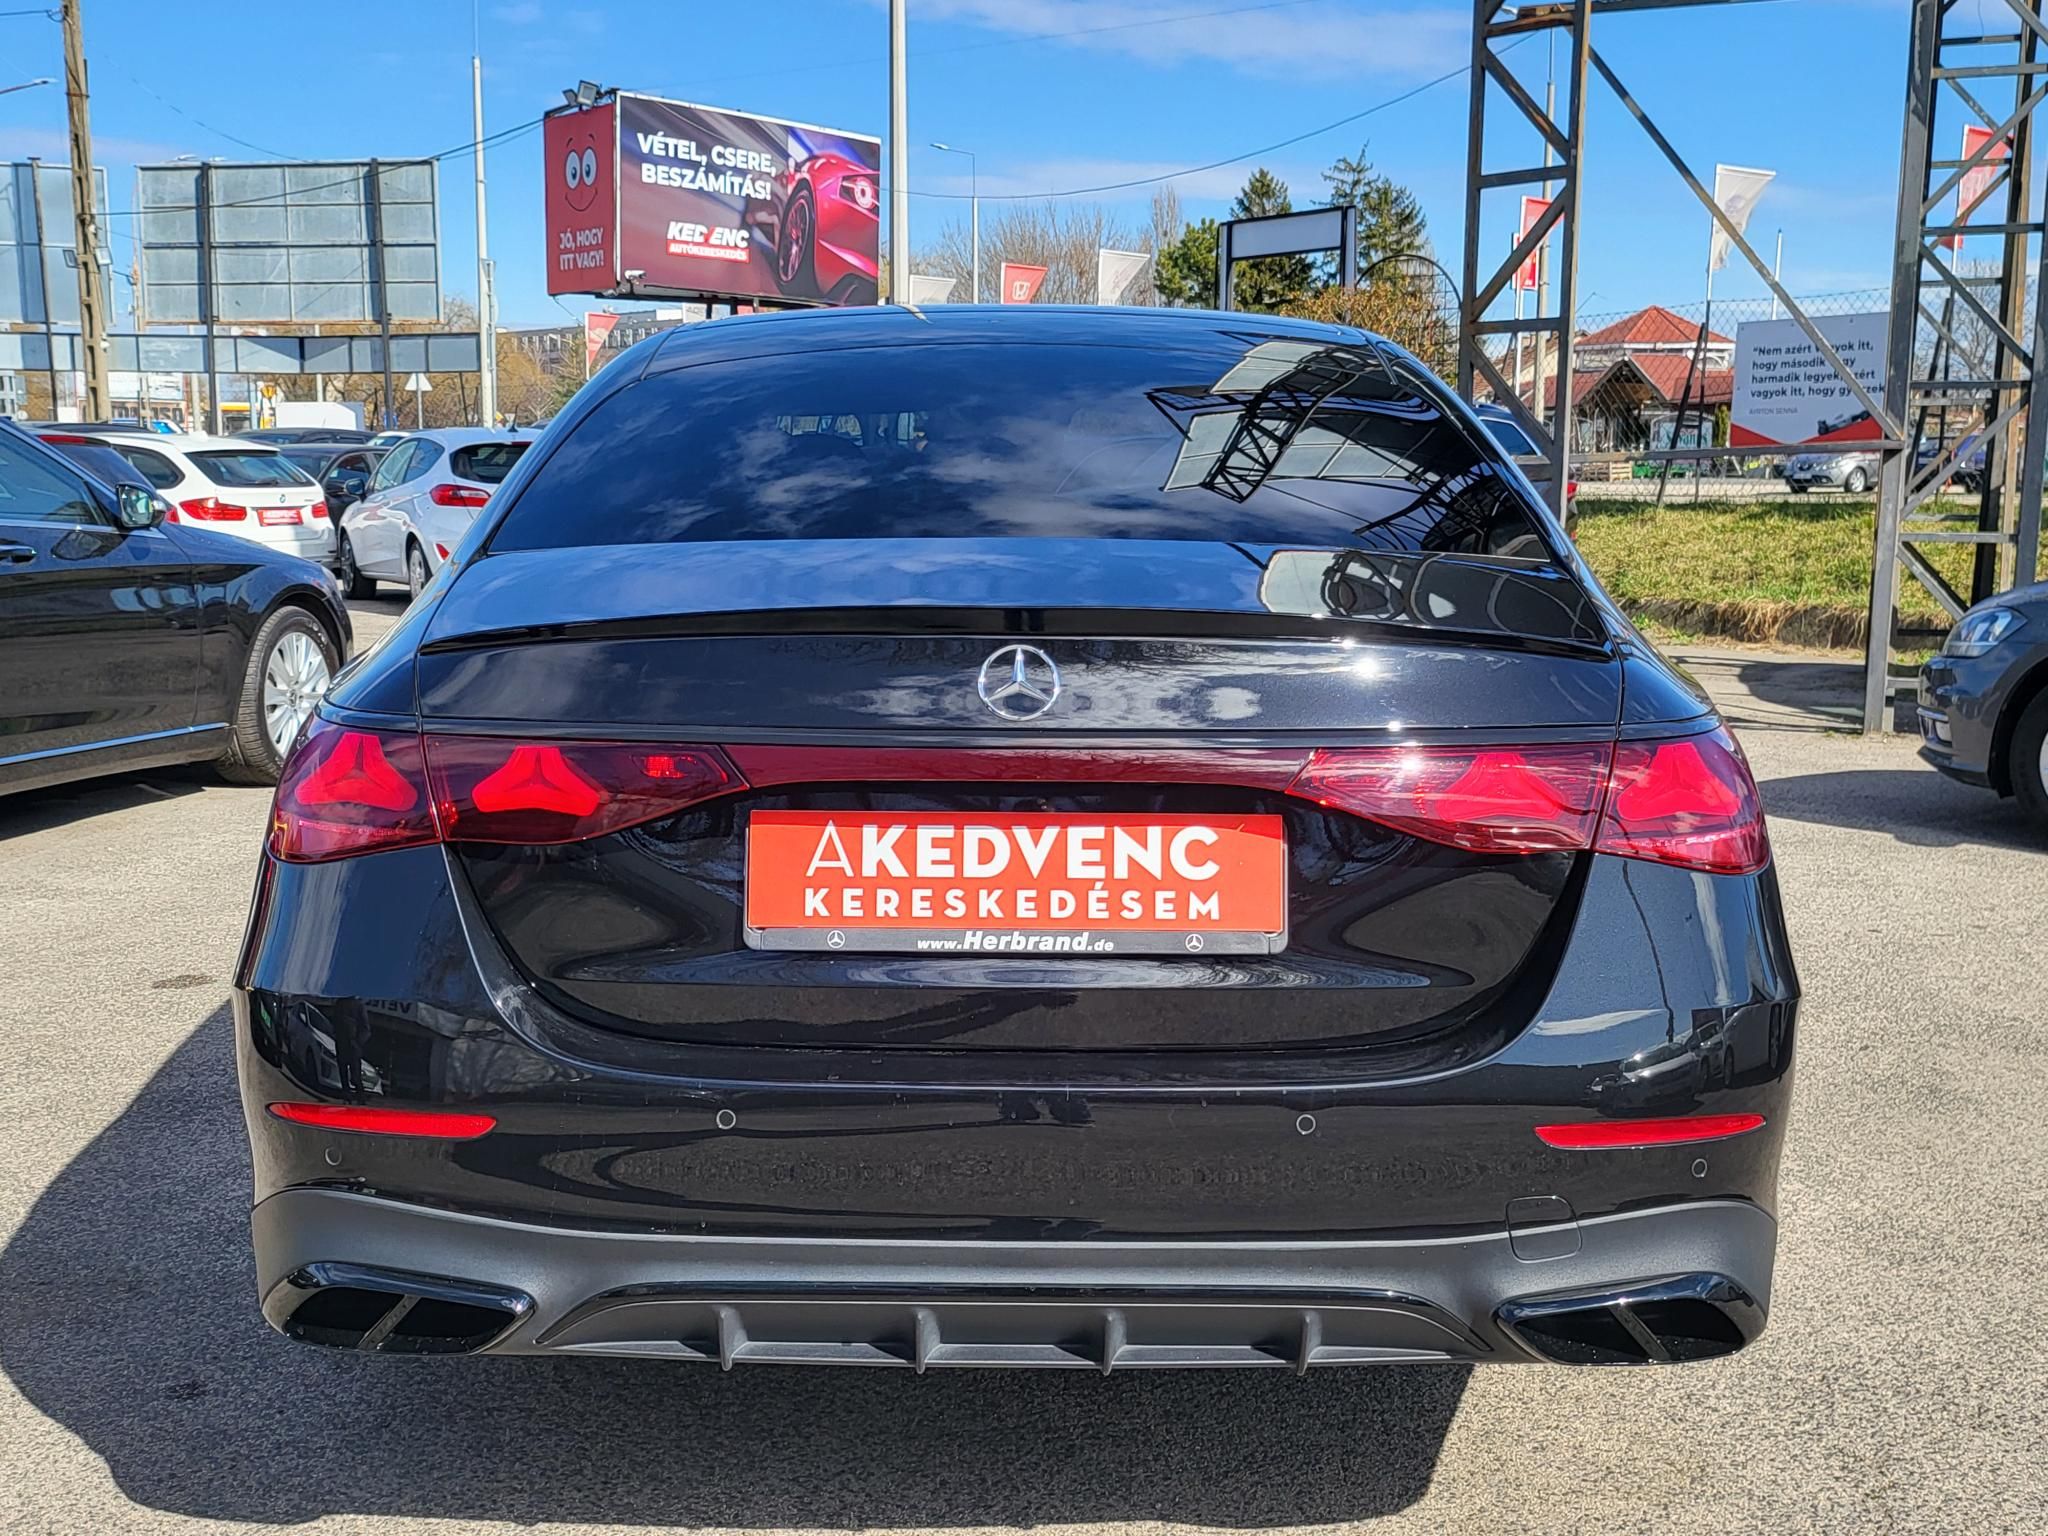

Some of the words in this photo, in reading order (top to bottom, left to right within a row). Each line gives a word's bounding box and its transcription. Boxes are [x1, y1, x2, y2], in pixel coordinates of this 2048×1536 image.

[637, 131, 707, 166] VÉTEL,
[711, 145, 777, 177] CSERE,
[641, 163, 772, 200] BESZÁMÍTÁS!
[560, 227, 576, 251] JÓ,
[576, 227, 604, 247] HOGY
[560, 253, 574, 270] ITT
[576, 249, 604, 269] VAGY!
[1784, 344, 1811, 355] azért
[1858, 339, 1874, 352] itt,
[1752, 360, 1778, 372] hogy
[1780, 356, 1825, 369] második
[1751, 371, 1800, 384] harmadik
[1854, 369, 1876, 380] zért
[1750, 386, 1787, 400] vagyok
[1790, 385, 1806, 398] itt,
[1808, 386, 1836, 398] hogy
[803, 881, 1221, 921] KERESKEDÉSEM
[917, 930, 1114, 951] www.Herbrand.de
